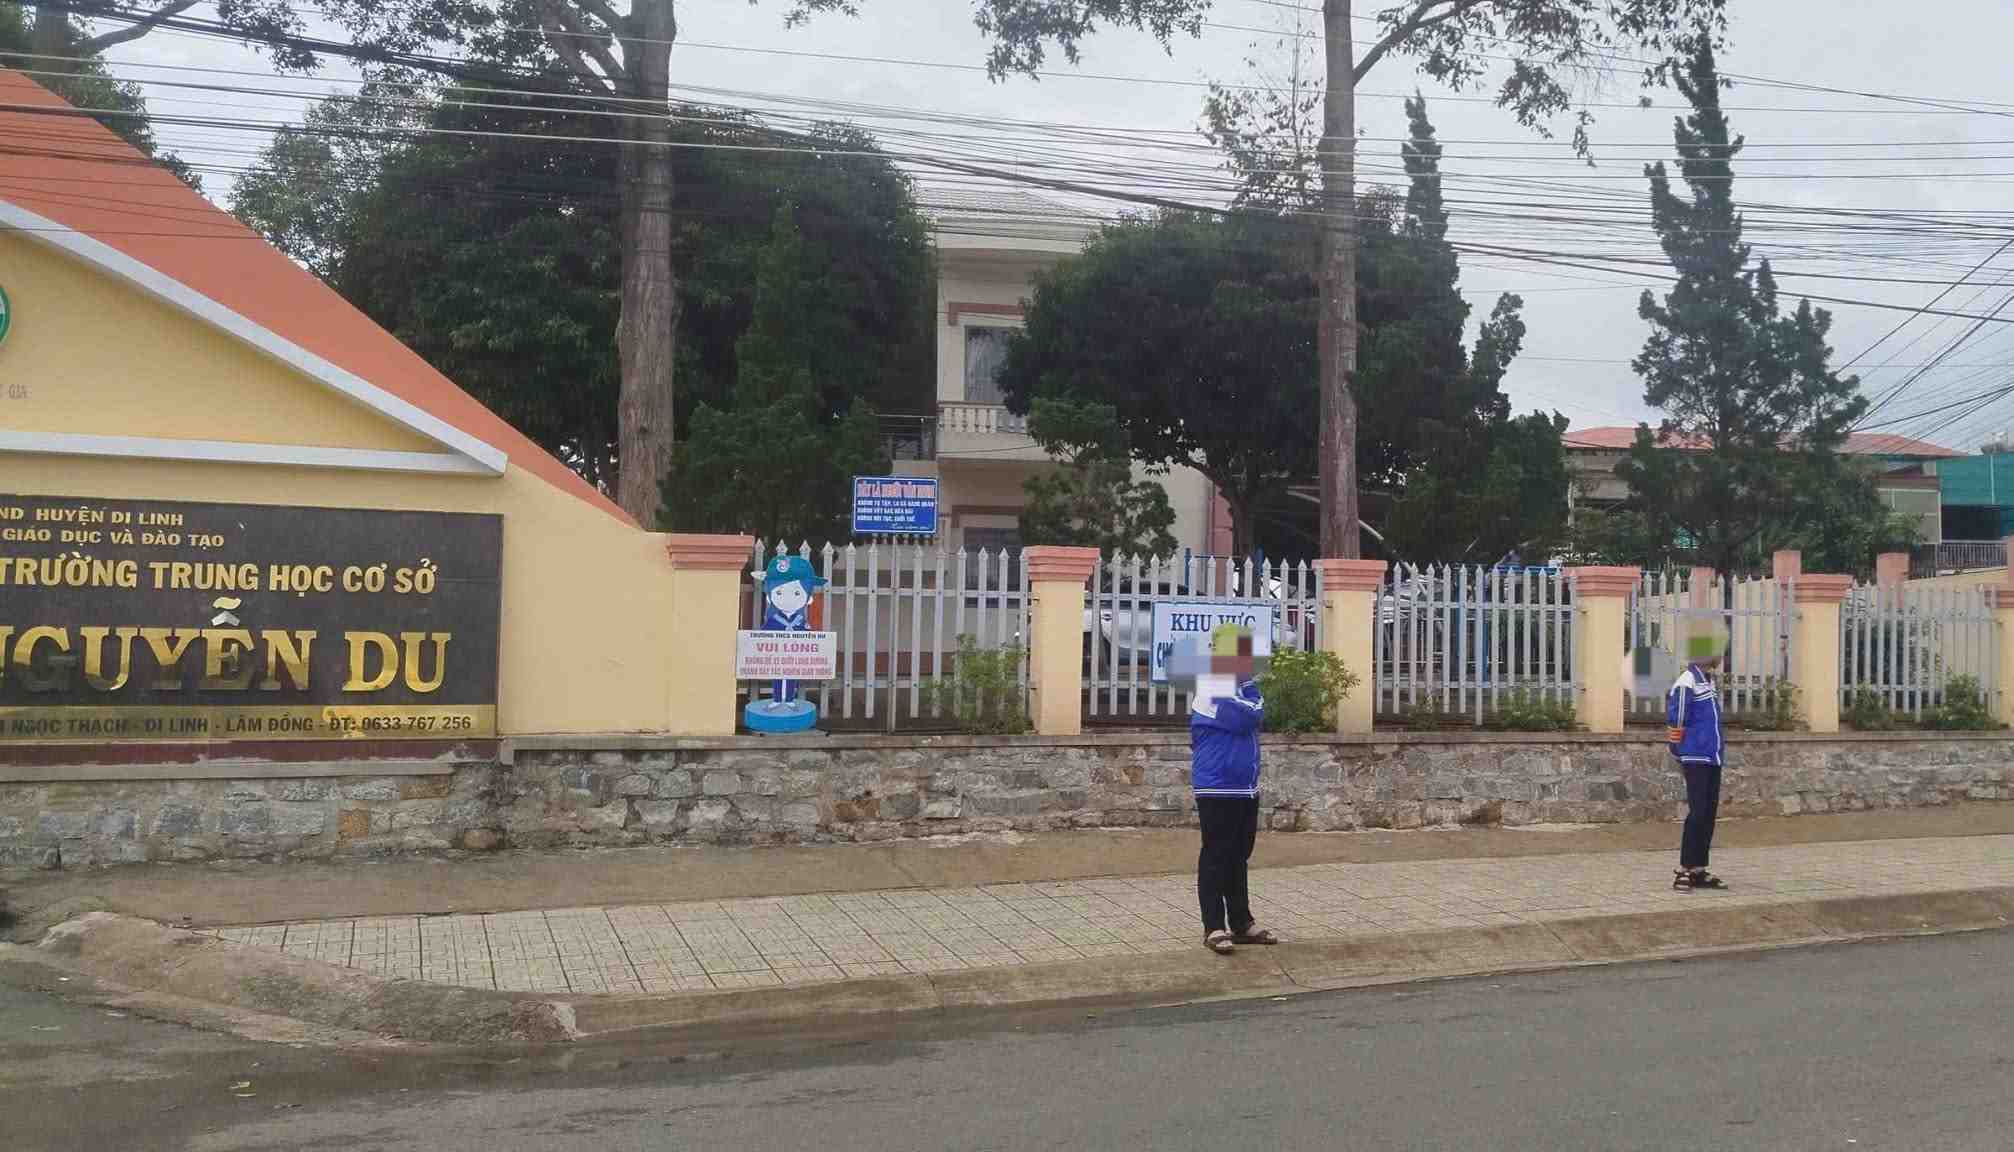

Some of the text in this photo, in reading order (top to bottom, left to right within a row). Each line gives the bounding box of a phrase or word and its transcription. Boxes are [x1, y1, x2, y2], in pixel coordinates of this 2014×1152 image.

[36, 506, 105, 526] HUYỆN
[111, 511, 131, 524] DI
[138, 512, 184, 527] LINH
[3, 525, 224, 550] GIÁO DỤC VÀ ĐÀO TẠO
[0, 551, 438, 597] TRƯỜNG TRUNG HỌC CƠ SỞ
[1170, 613, 1212, 633] KHU
[756, 640, 819, 653] VUI LÒNG
[342, 631, 452, 694] DU
[144, 718, 163, 733] DI
[169, 717, 208, 733] LINH
[226, 714, 262, 732] LÂM
[268, 711, 314, 732] ĐỒNG
[329, 715, 357, 732] ĐT:
[362, 715, 401, 731] 0633
[407, 714, 436, 731] 767
[441, 714, 472, 730] 256
